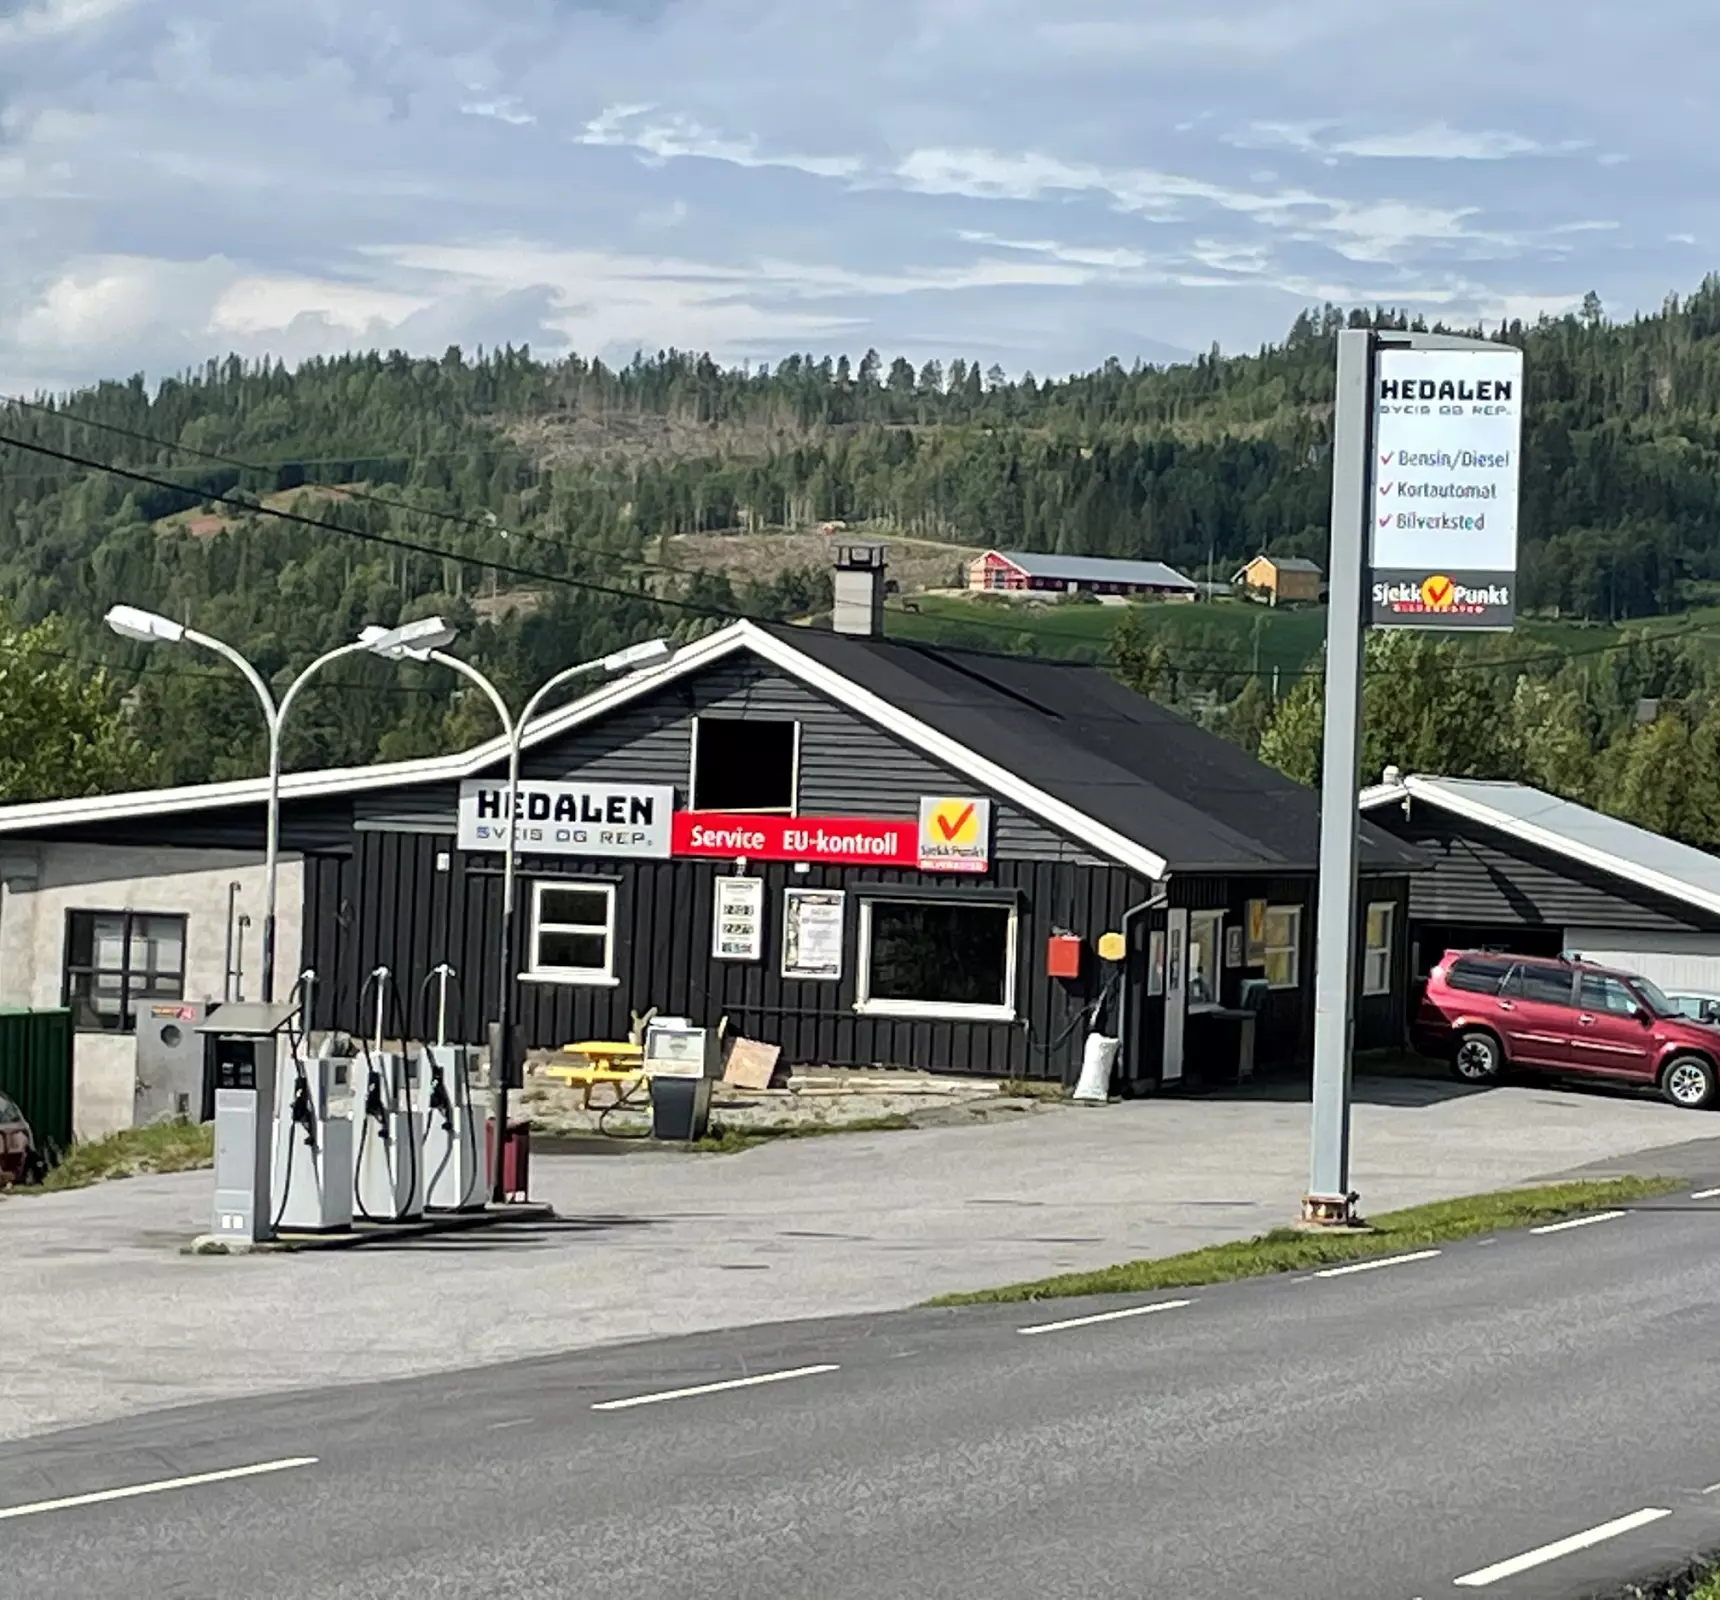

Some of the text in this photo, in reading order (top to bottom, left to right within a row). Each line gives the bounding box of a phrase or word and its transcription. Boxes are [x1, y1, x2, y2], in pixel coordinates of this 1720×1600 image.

[1381, 379, 1512, 401] HEDALEN
[1398, 449, 1509, 471] Bensin/Diesel
[1397, 481, 1497, 499] Kortautomat
[1396, 512, 1485, 531] Bilverksted
[1372, 582, 1509, 607] Sjekk Punkt
[478, 790, 654, 825] HEDALEN
[556, 828, 588, 843] OG
[690, 825, 898, 856] Service EU-kontroll
